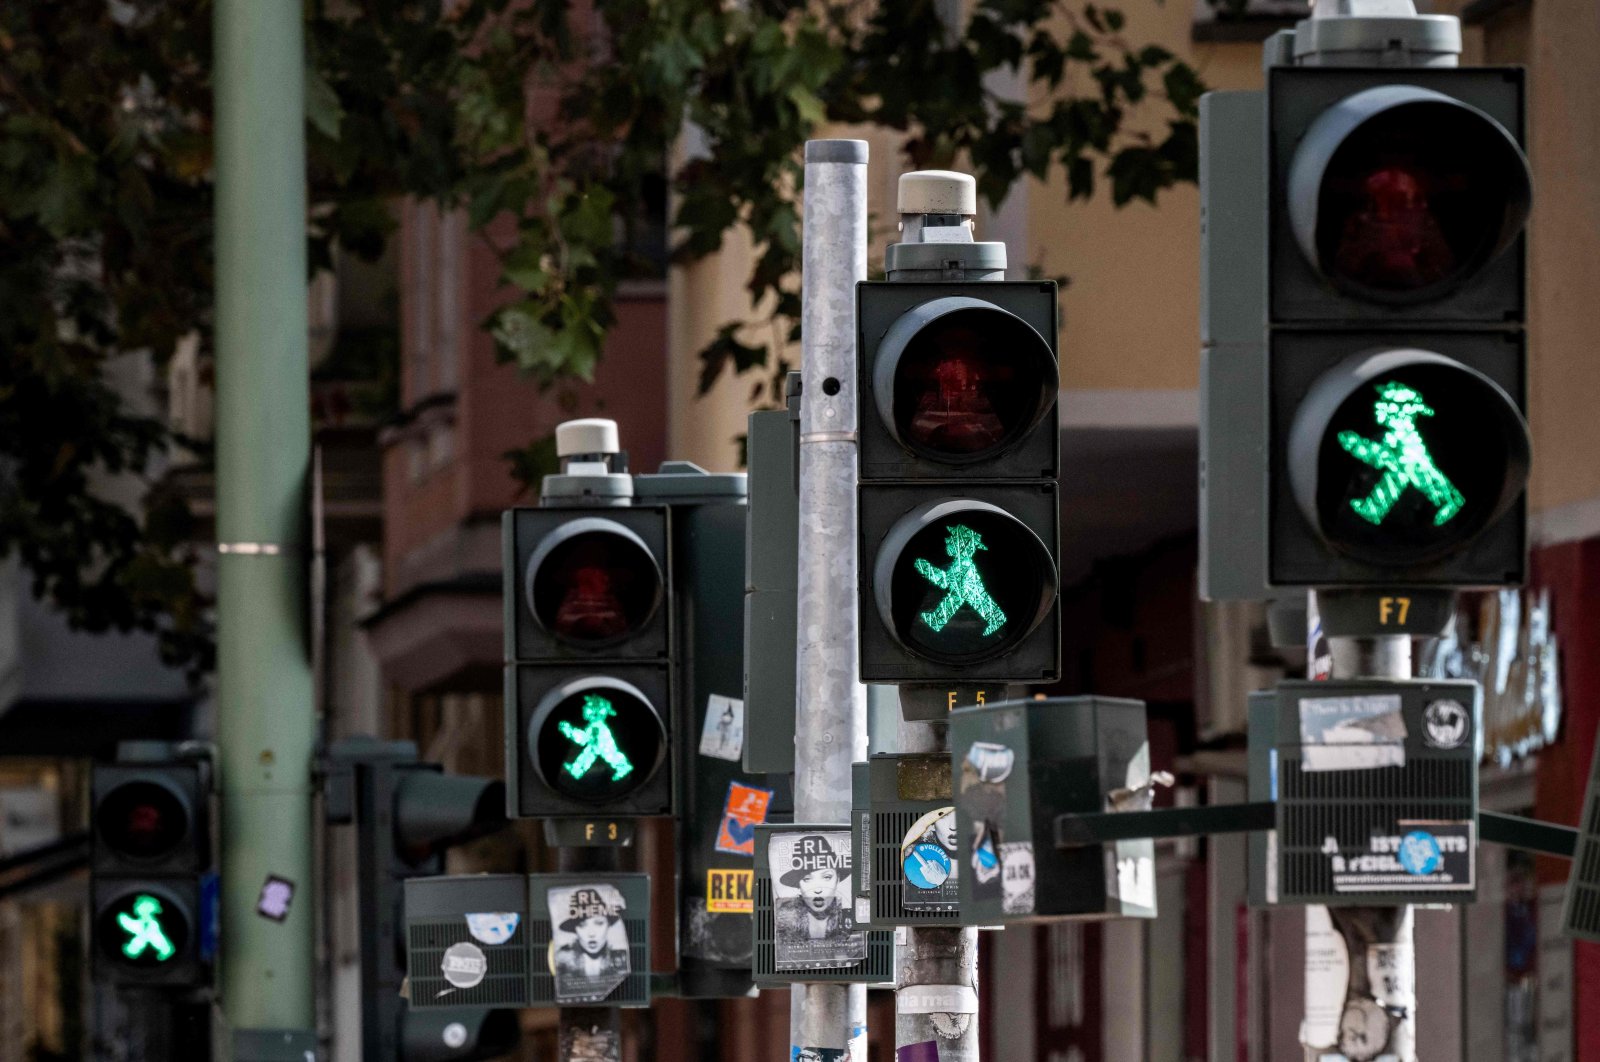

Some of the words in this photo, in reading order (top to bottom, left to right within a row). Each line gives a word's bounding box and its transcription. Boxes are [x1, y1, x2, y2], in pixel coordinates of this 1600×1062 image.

[1379, 597, 1410, 625] F7
[948, 691, 957, 711] F
[976, 691, 985, 708] 5
[585, 823, 594, 840] F
[608, 822, 617, 840] 3
[711, 873, 754, 900] REK
[569, 903, 622, 920] OHEME
